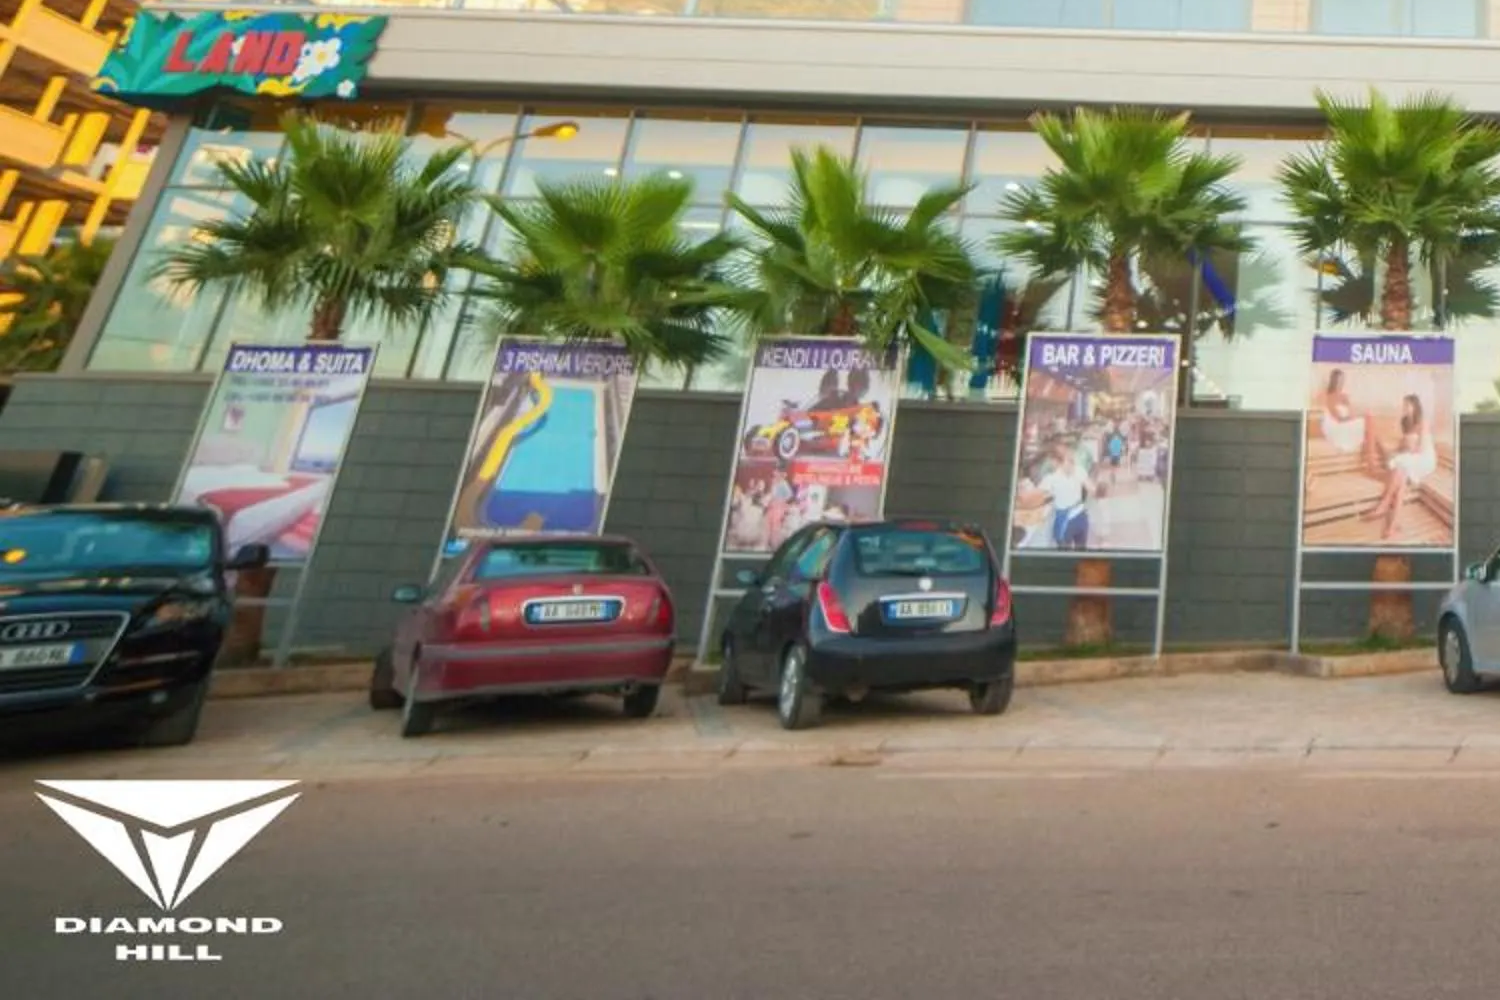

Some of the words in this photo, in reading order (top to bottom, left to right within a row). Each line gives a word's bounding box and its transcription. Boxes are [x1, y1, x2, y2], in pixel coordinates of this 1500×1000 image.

[163, 30, 306, 75] LAND
[230, 350, 294, 371] DHOMA
[297, 352, 312, 371] &
[314, 353, 363, 373] SUITA
[1042, 343, 1080, 365] BAR
[1082, 344, 1096, 365] &
[1101, 345, 1166, 367] PIZZERI
[1351, 343, 1414, 363] SAUNA
